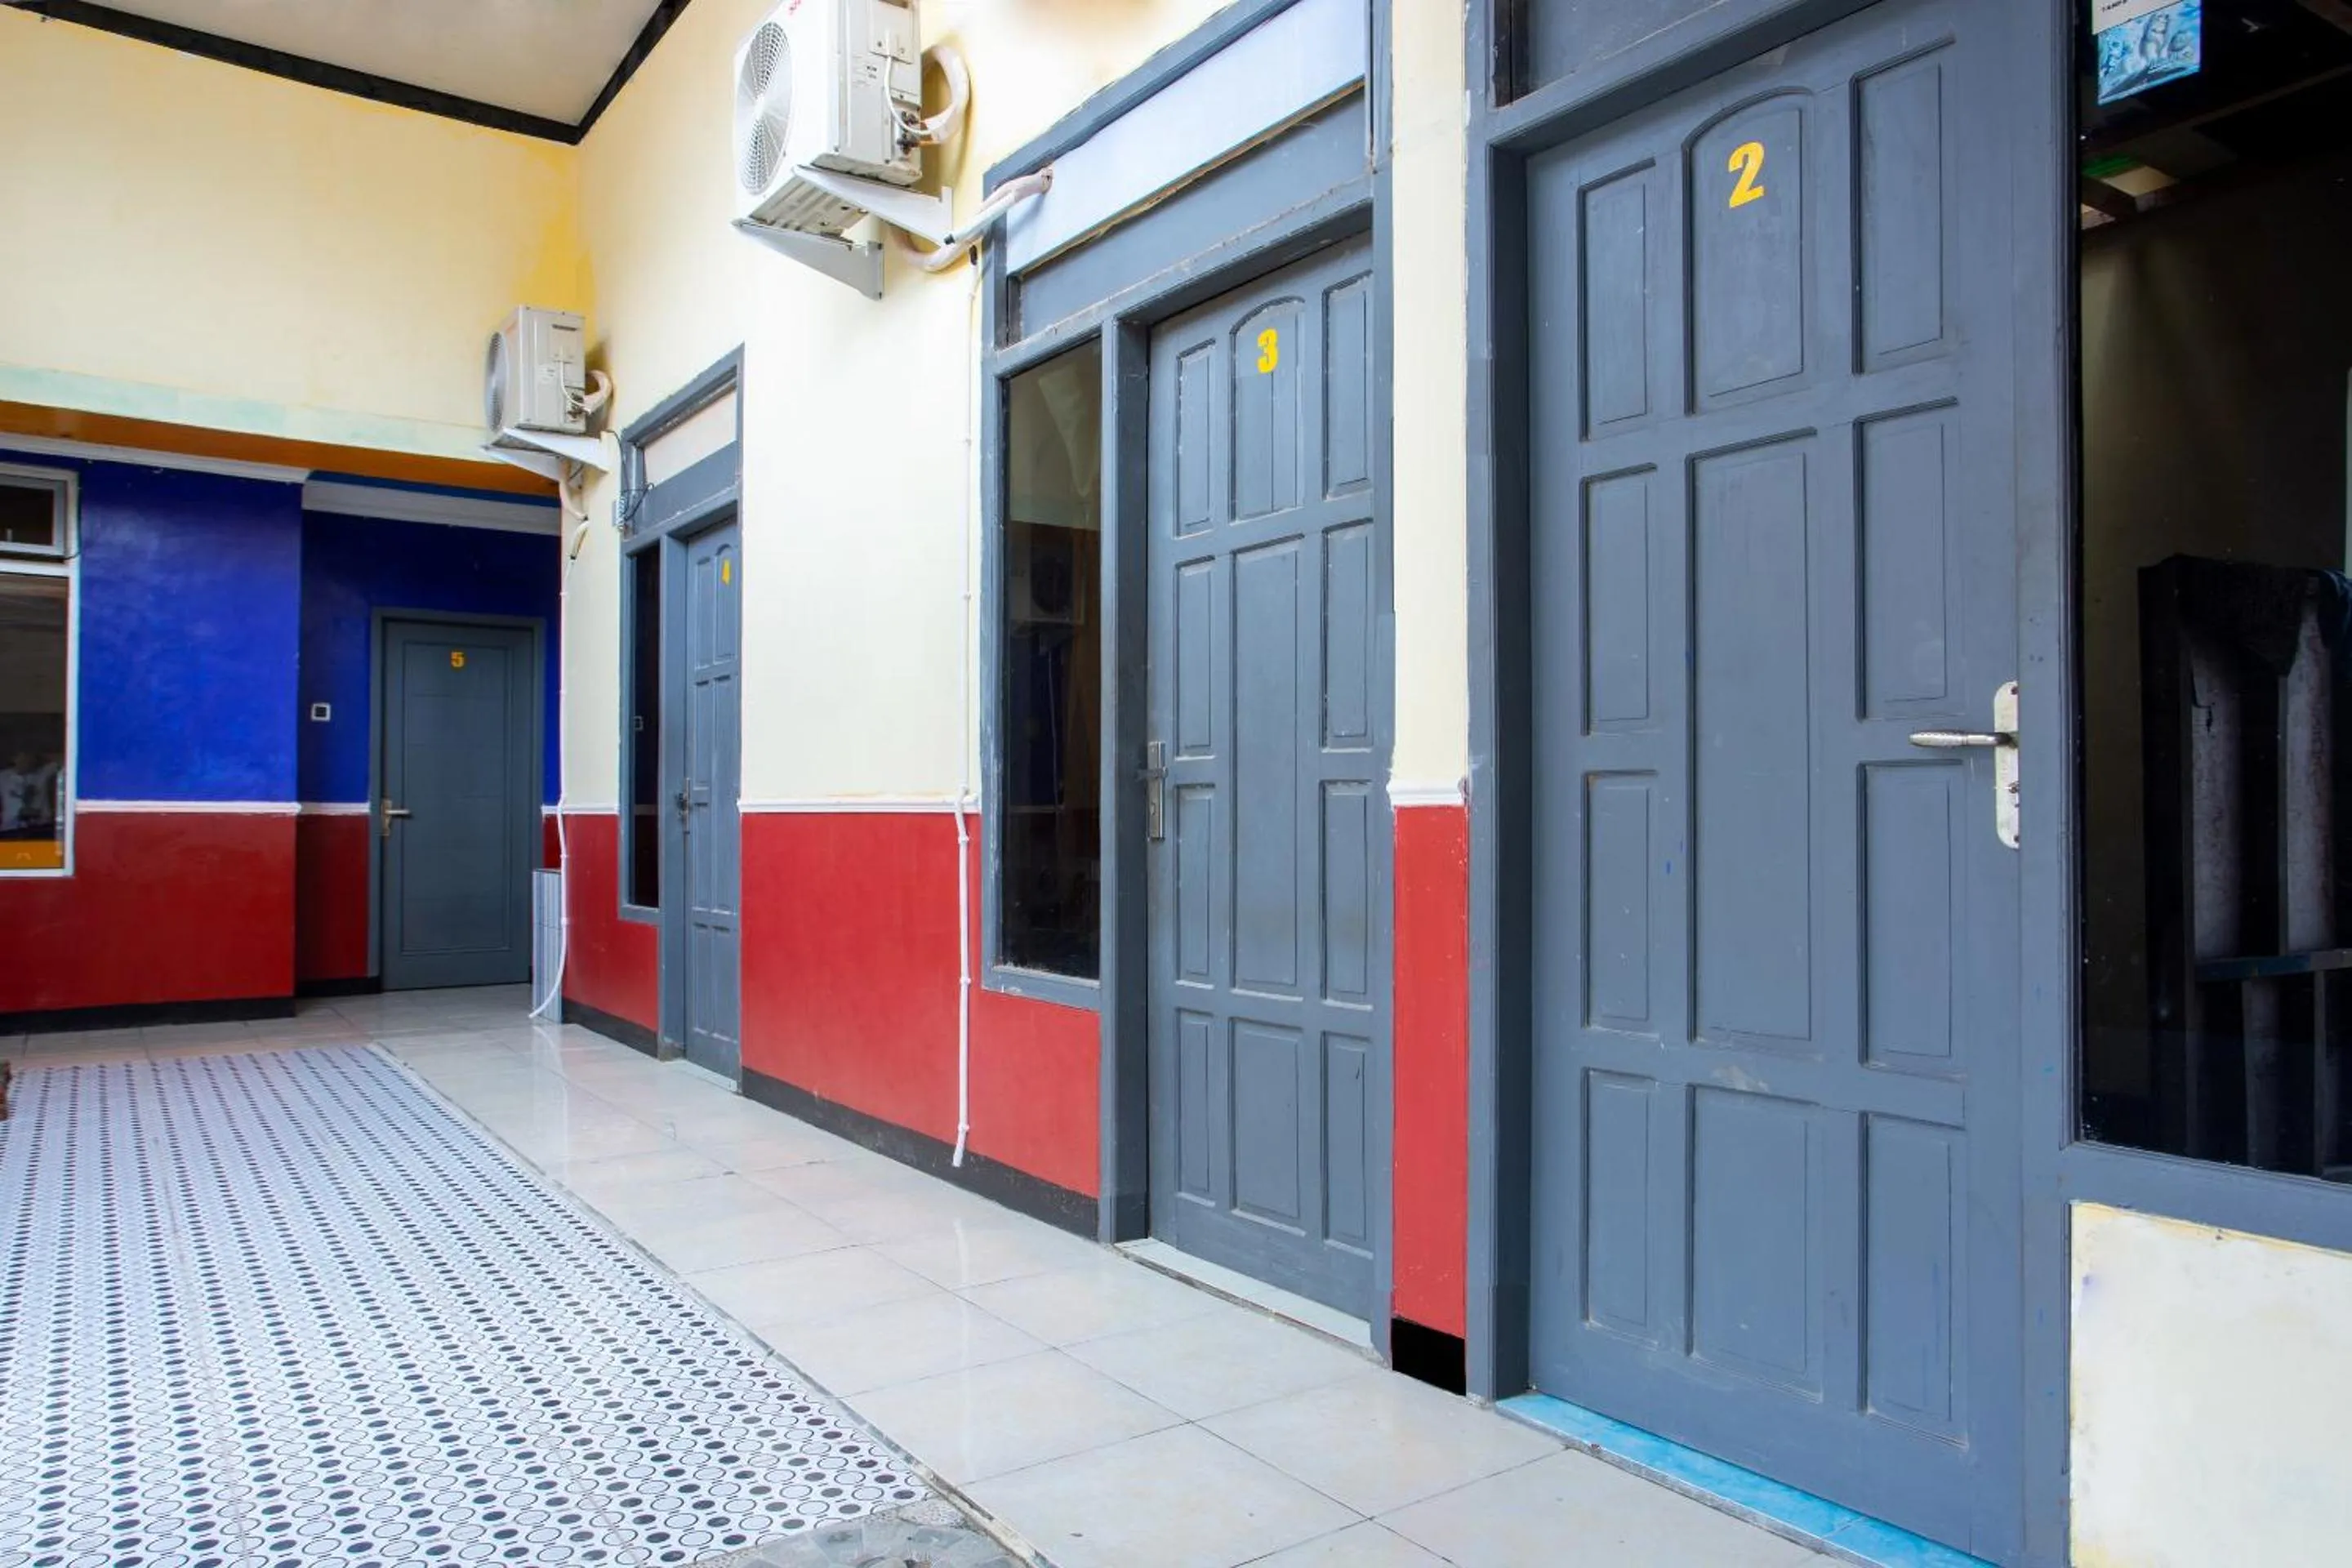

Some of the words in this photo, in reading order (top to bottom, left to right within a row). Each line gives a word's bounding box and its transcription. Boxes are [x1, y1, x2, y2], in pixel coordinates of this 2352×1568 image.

[1728, 141, 1764, 207] 2
[1258, 327, 1278, 373] 3
[450, 651, 465, 668] 5
